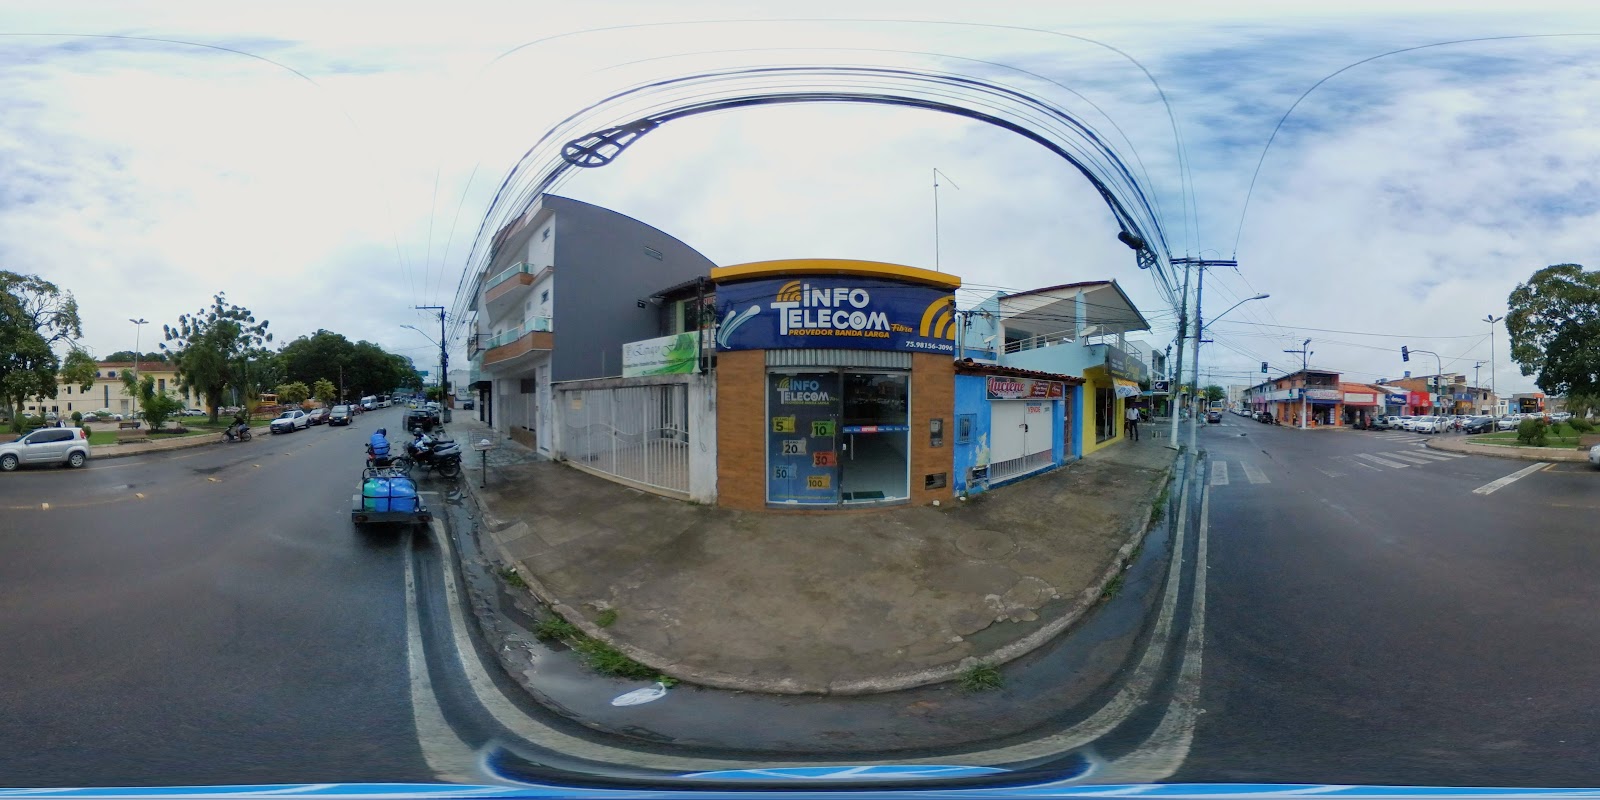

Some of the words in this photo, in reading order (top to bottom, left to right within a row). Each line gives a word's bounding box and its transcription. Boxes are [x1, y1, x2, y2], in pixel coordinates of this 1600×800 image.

[803, 283, 870, 309] INFO
[770, 301, 890, 336] TELECOM
[890, 323, 913, 333] Fibra
[788, 328, 833, 337] PROVEDOR
[834, 329, 863, 338] BANDA
[864, 330, 890, 339] LARGA
[790, 378, 819, 391] INFO
[988, 377, 1025, 397] Luciene
[777, 388, 829, 405] TELECOM
[775, 421, 784, 431] 5
[814, 426, 827, 436] 10
[784, 444, 798, 454] 20
[815, 456, 828, 465] 30
[775, 469, 787, 479] 50
